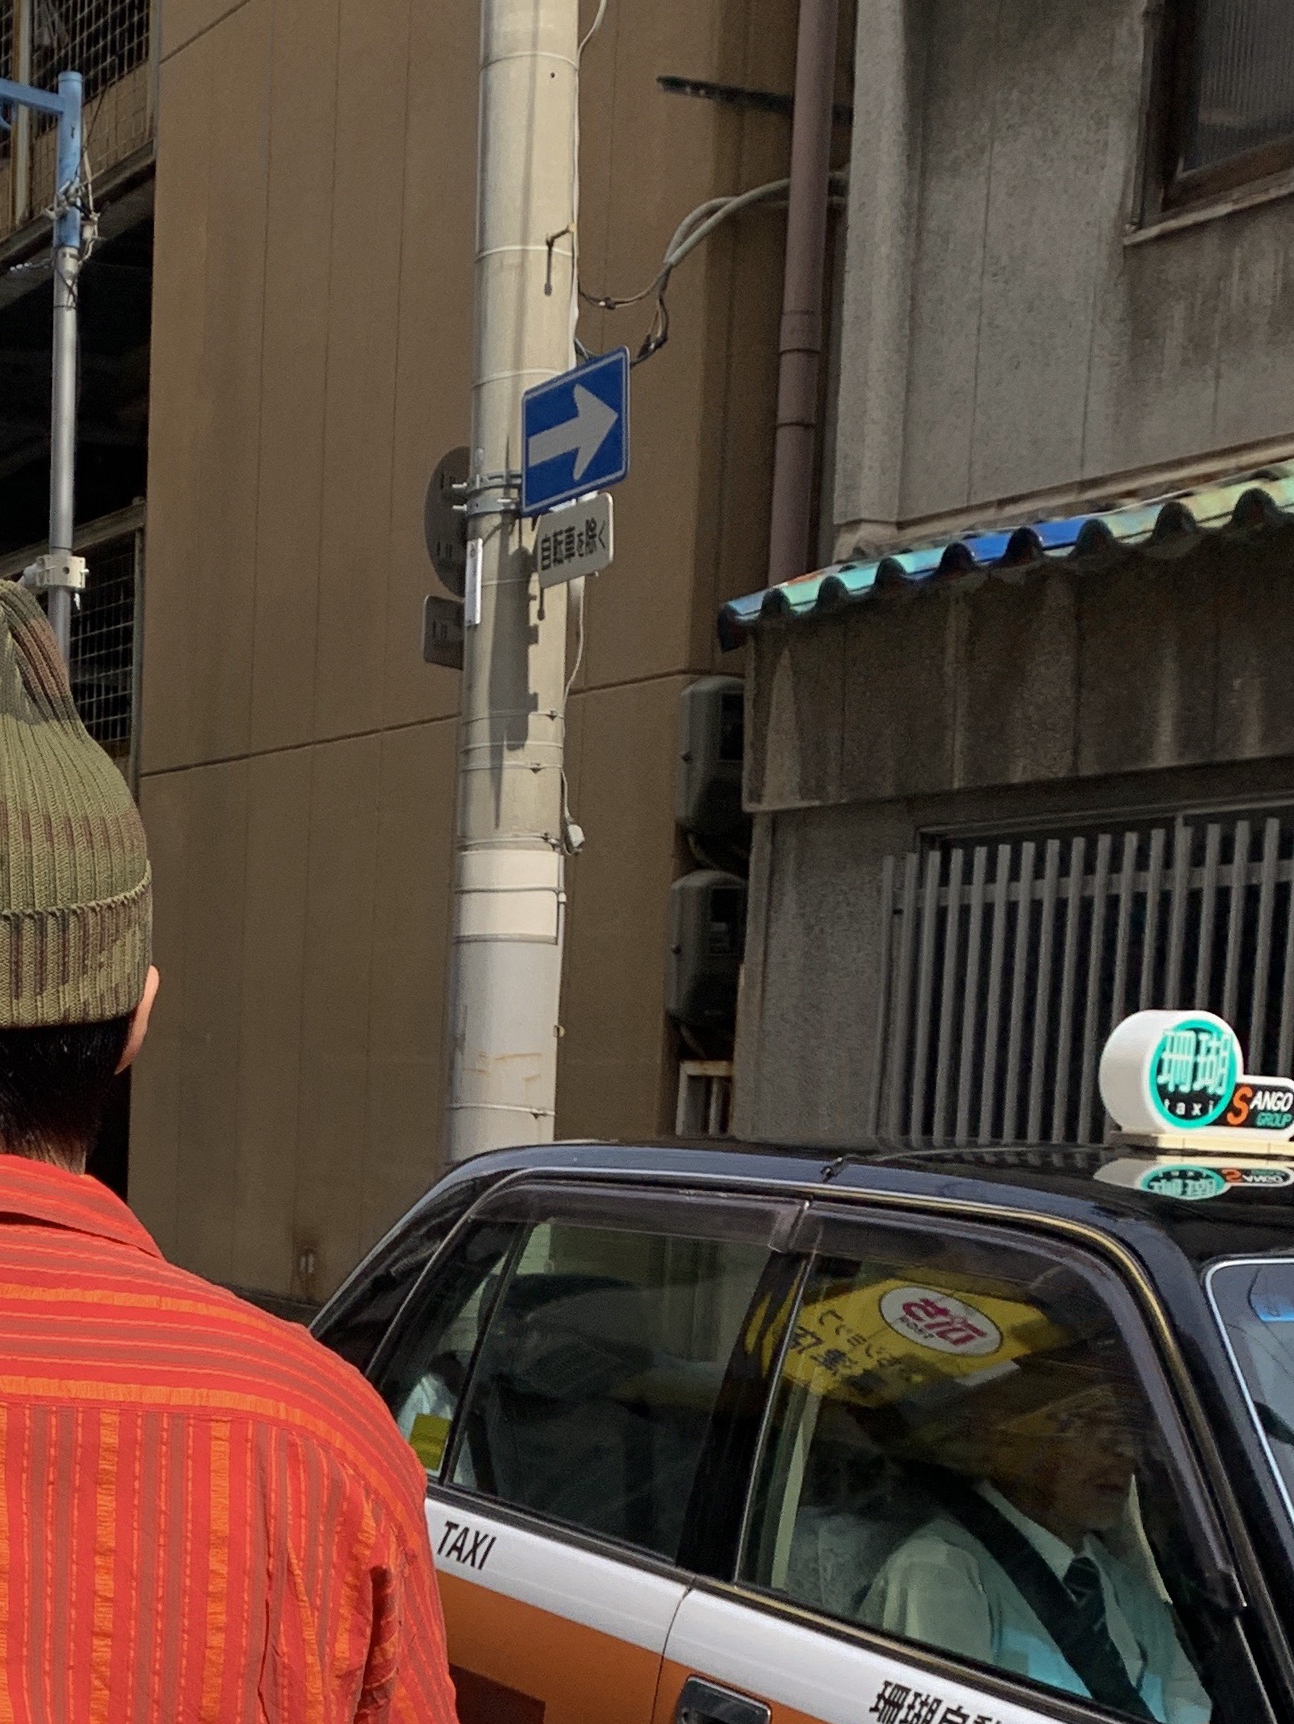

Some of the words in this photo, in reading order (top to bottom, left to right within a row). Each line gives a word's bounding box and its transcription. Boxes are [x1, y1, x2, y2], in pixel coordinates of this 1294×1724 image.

[1163, 1098, 1215, 1116] taxi
[1226, 1084, 1294, 1125] SANGO
[1256, 1112, 1292, 1128] GROUP
[437, 1520, 497, 1571] TAXI
